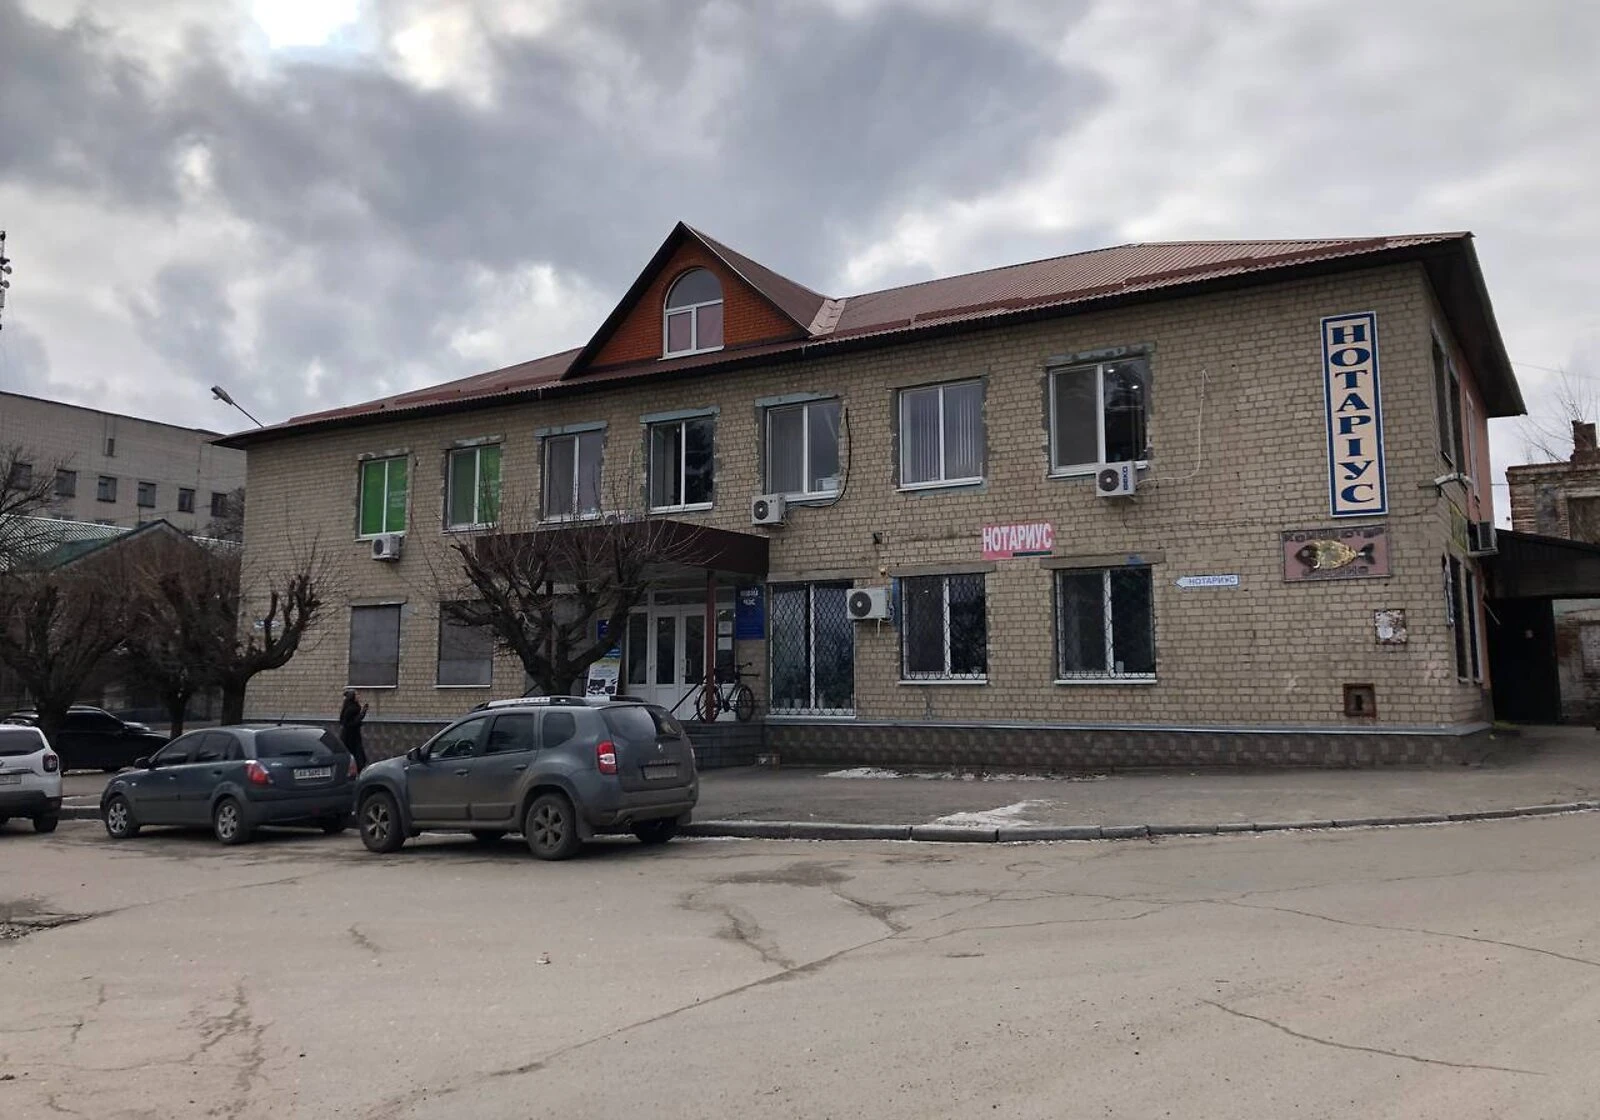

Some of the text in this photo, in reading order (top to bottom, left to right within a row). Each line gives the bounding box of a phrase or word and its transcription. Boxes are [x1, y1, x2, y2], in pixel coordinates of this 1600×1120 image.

[1330, 324, 1374, 503] НОТАРІУС
[983, 523, 1052, 551] НОТАРИУС
[1188, 575, 1237, 585] НОТАРИУС
